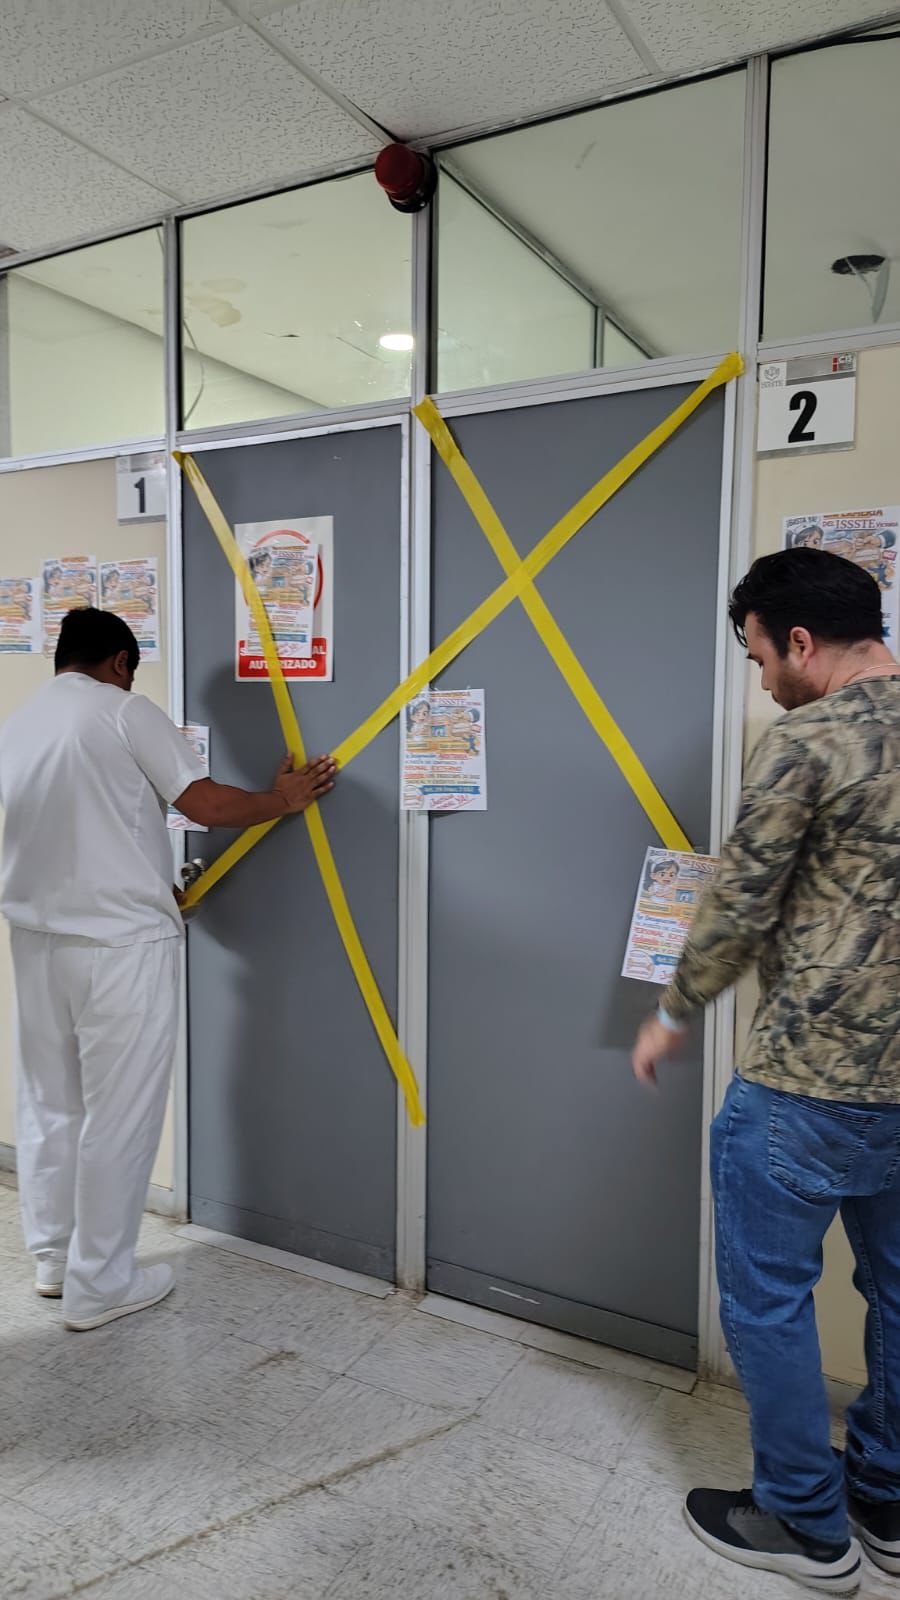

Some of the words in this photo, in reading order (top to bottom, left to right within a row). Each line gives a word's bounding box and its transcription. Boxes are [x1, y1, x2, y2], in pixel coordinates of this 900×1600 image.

[788, 390, 817, 443] 2
[134, 477, 145, 513] 1
[836, 519, 876, 529] ISSSTE
[248, 659, 317, 670] AUTRIZADO
